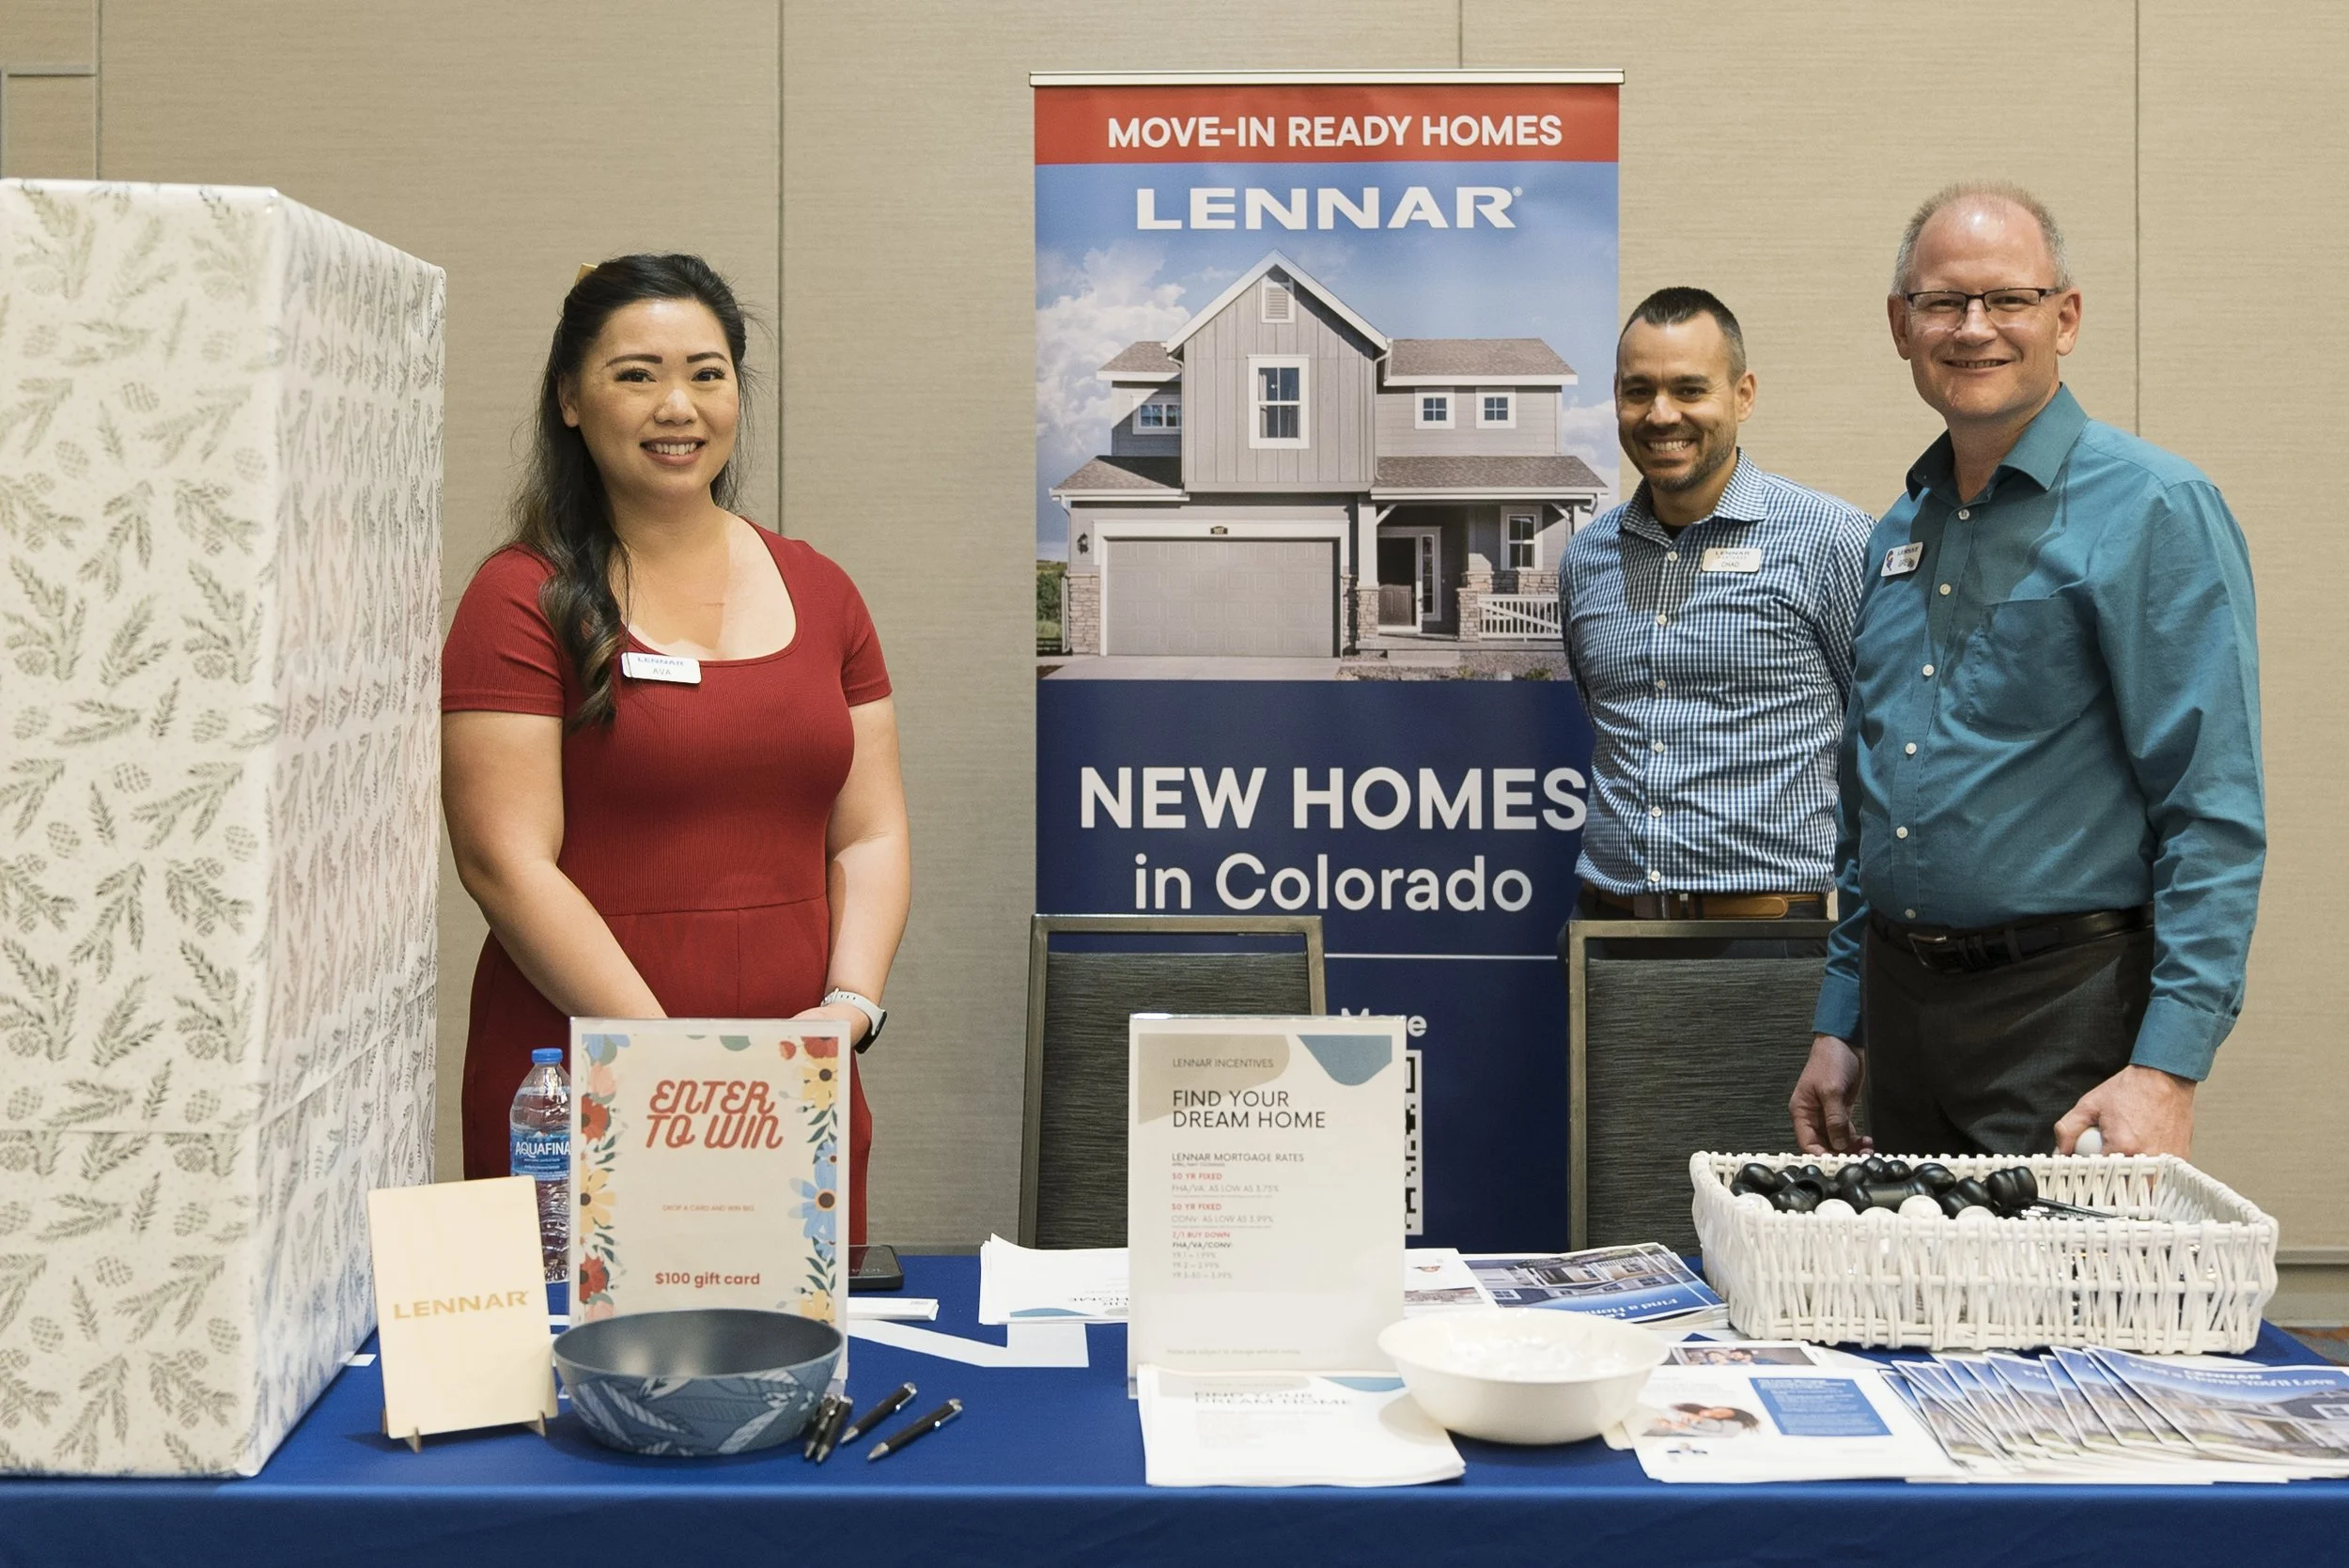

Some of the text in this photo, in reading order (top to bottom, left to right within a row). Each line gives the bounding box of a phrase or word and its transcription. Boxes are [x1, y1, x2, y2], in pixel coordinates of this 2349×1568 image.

[1108, 115, 1563, 147] MOVE-IN READY HOMES
[637, 657, 684, 666] LENNAR
[652, 668, 672, 676] AVA
[1081, 767, 1587, 831] NEW HOMES
[1135, 852, 1532, 911] in Colorado
[1173, 1059, 1274, 1068] LENNAR INCENTIVES
[649, 1079, 776, 1114] ENTER
[1173, 1090, 1289, 1108] FIND YOUR
[1173, 1111, 1326, 1128] DREAM HOME
[646, 1114, 784, 1149] TO WIN
[515, 1141, 571, 1158] AQUAFINA
[1172, 1153, 1305, 1162] LENNAR MORTGAGE RATES
[655, 1272, 760, 1288] $100 gift card
[394, 1291, 529, 1320] LENNAR
